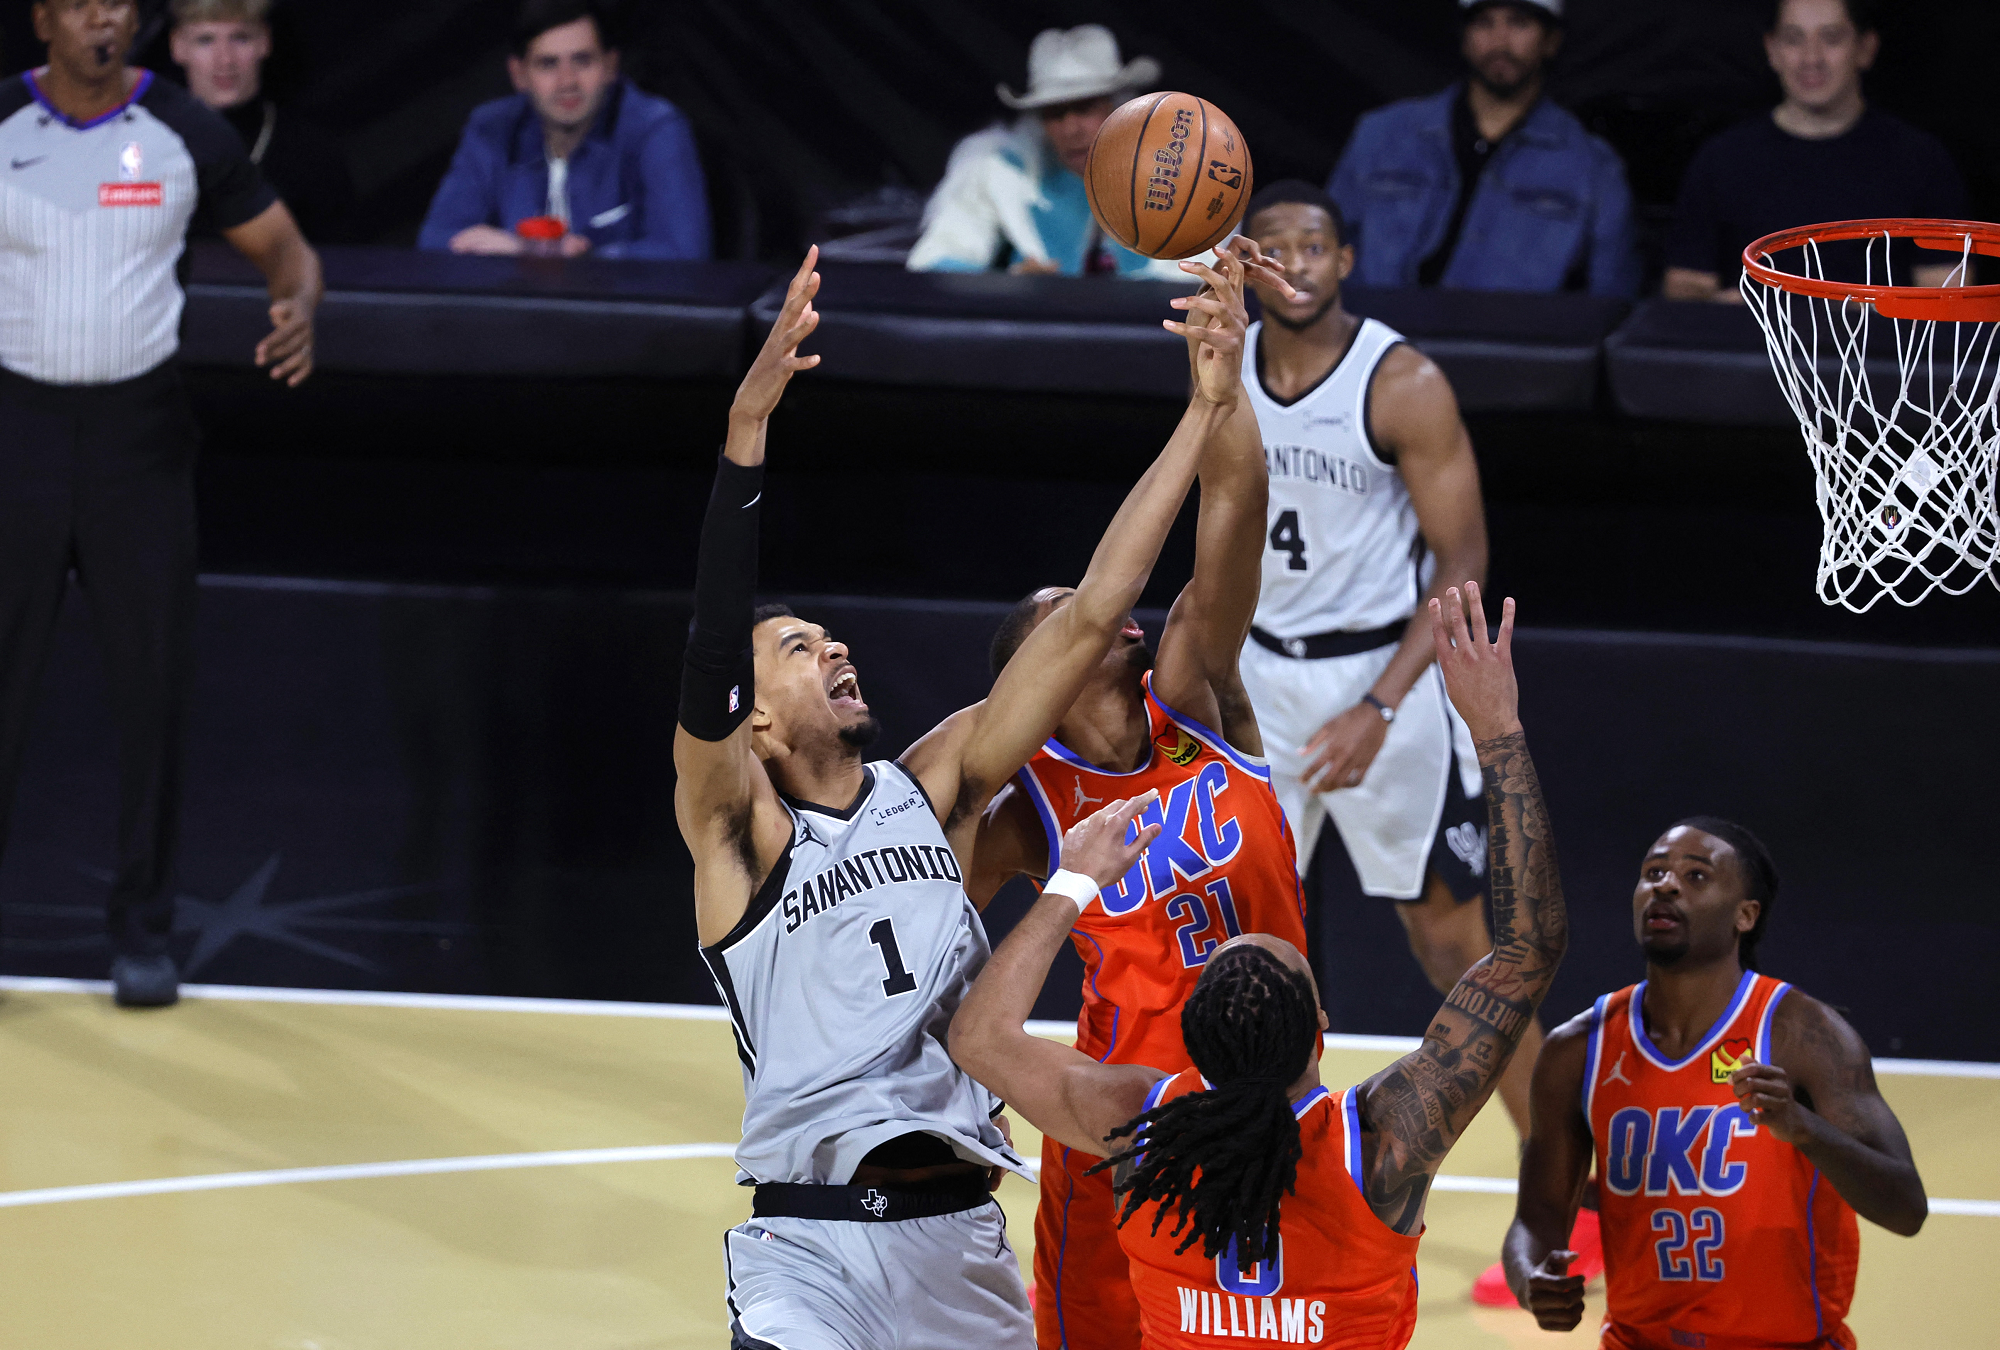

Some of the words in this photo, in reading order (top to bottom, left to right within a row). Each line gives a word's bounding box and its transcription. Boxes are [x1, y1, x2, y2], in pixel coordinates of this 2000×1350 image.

[1143, 108, 1195, 212] Wilson
[1269, 509, 1308, 571] 4
[878, 797, 917, 820] LEDGER
[867, 916, 919, 999] 1
[1165, 876, 1243, 969] 21
[1606, 1102, 1757, 1197] OKC
[1651, 1206, 1725, 1282] 22
[1177, 1286, 1326, 1344] WILLIAMS
